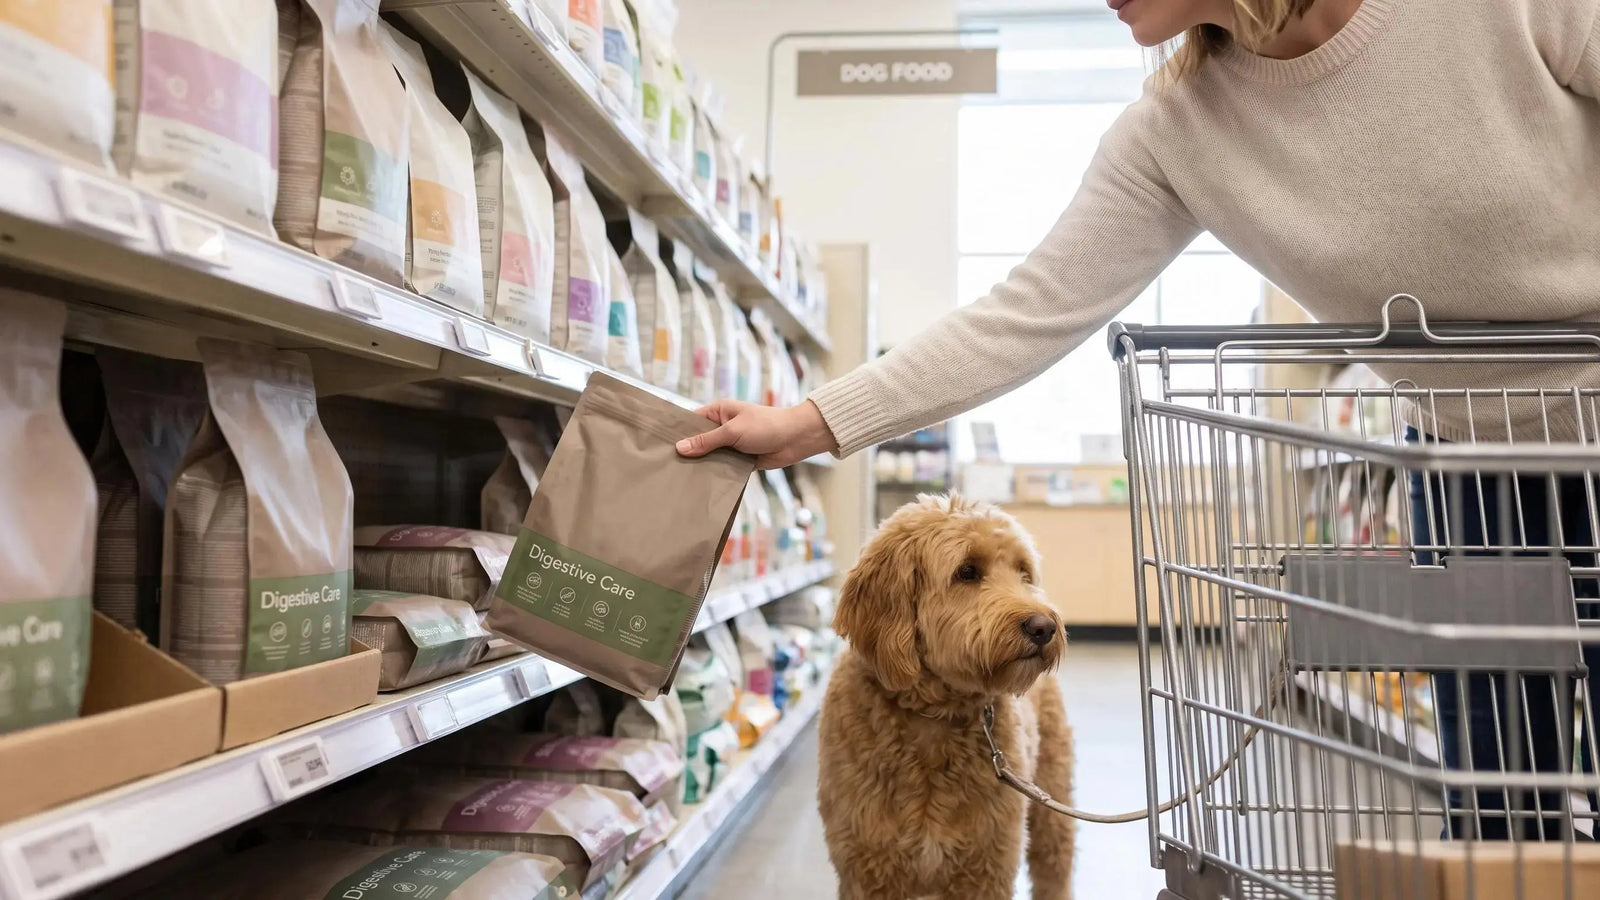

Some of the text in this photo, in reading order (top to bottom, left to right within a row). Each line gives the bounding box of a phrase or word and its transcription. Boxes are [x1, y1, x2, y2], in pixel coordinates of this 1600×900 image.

[840, 62, 954, 83] DOG FOOD
[528, 543, 636, 601] Digestive Care
[261, 585, 341, 613] Digestive Care
[342, 863, 403, 900] Digestive
